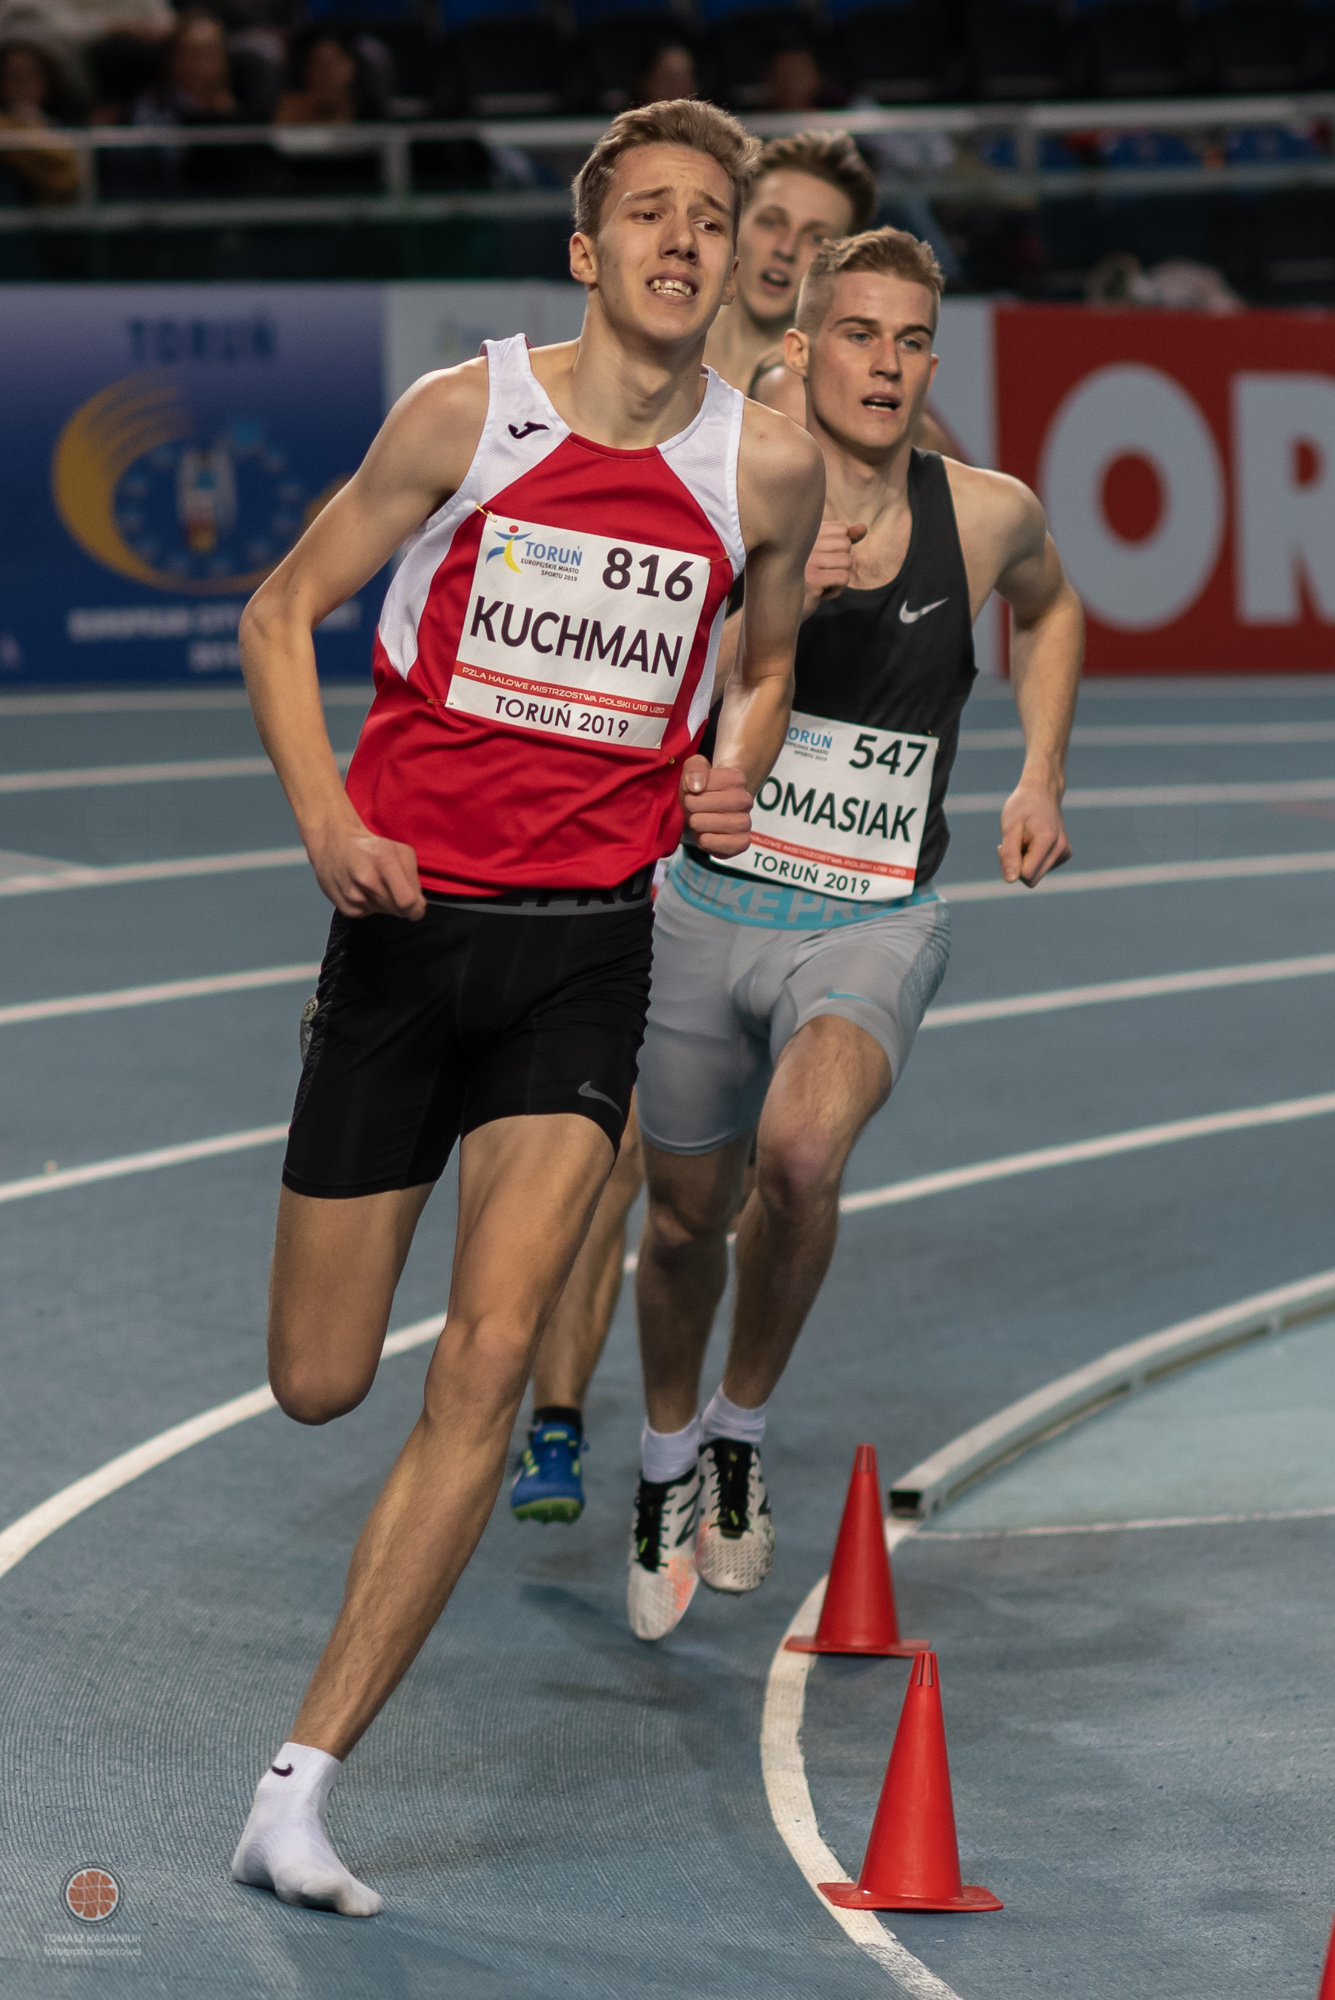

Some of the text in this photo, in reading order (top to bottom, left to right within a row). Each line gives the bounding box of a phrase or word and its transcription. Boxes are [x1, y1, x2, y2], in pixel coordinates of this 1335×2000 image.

[520, 558, 579, 574] EUROPEJSKIE MIASTO
[525, 541, 583, 567] TORUŃ
[602, 547, 695, 601] 816
[541, 570, 578, 582] SPORTU 2019
[469, 595, 683, 677] KUCHMAN
[462, 666, 665, 714] PZLA HALOWE MISTRZOSTWA POLSKI U18 U20
[495, 695, 629, 738] TORUŃ 2019
[787, 727, 833, 749] ORUŃ
[848, 733, 928, 777] 547
[755, 776, 917, 843] OMASIAK
[677, 859, 783, 921] NIKE
[754, 852, 871, 895] TORUŃ 2019
